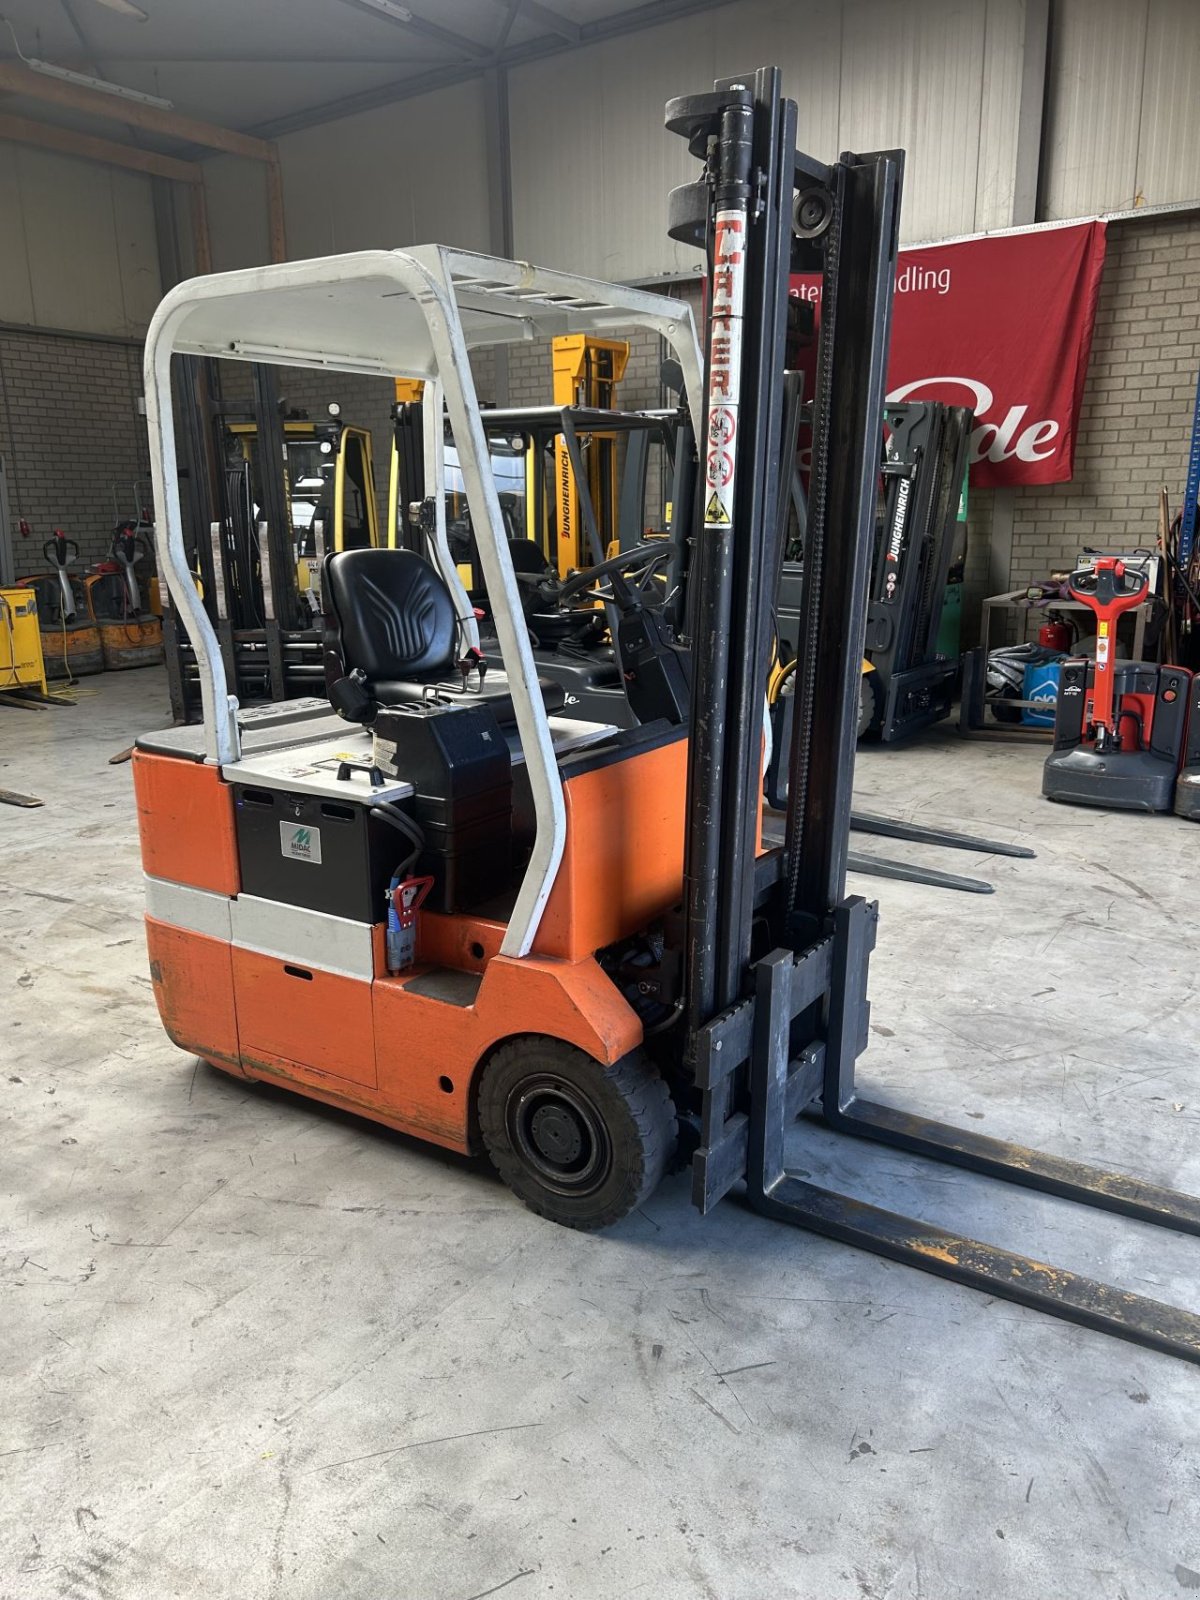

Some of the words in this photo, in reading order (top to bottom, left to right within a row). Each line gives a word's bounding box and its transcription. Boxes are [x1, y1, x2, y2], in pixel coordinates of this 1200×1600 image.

[893, 266, 951, 295] dling
[560, 451, 571, 540] JUNGHEINRICH
[886, 478, 910, 563] JUNGHEINRICH
[291, 841, 311, 853] MIDAC
